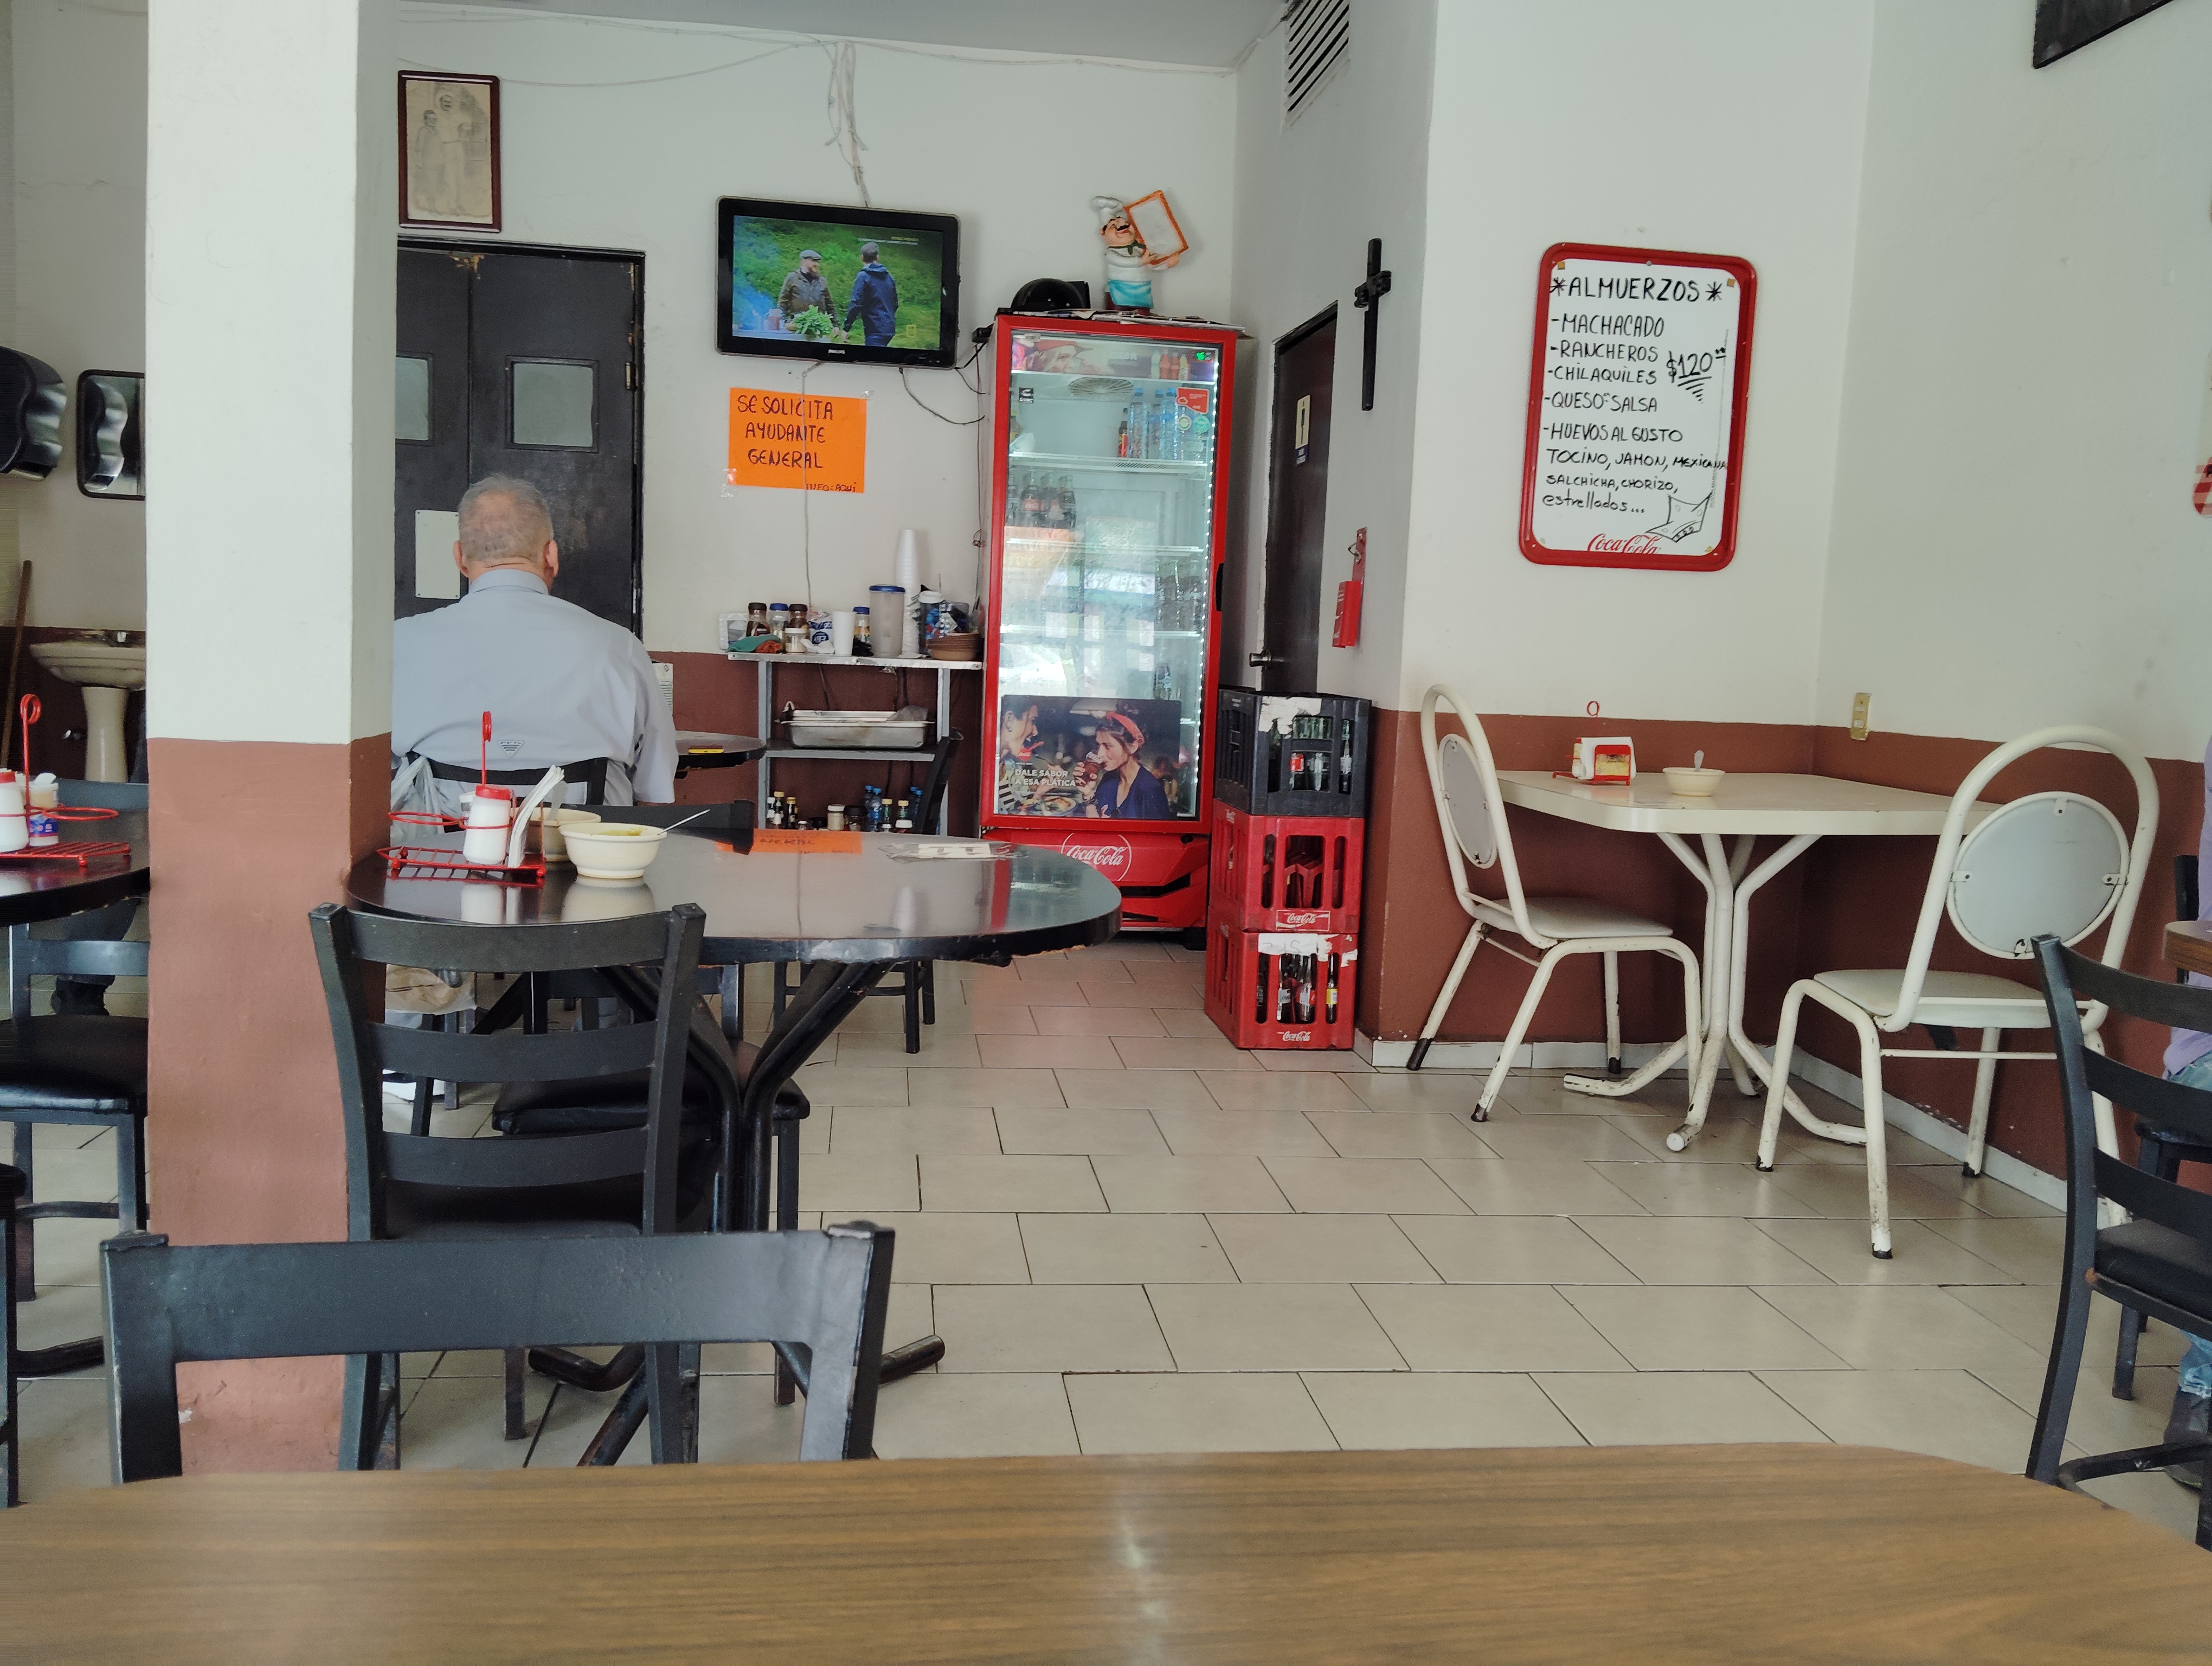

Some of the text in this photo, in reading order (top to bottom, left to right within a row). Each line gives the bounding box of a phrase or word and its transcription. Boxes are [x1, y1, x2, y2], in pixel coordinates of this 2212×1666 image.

[737, 395, 833, 420] SE SOLICITA
[1610, 395, 1657, 413] SALSA
[745, 422, 825, 443] AYUDANTE
[1611, 426, 1629, 442] AL
[1632, 426, 1683, 443] GUSTO
[748, 448, 824, 469] GENERAL
[1587, 533, 1663, 555] Coca-Cola
[1015, 768, 1069, 778] DALE SABOR
[1066, 845, 1128, 866] Coca-Cola
